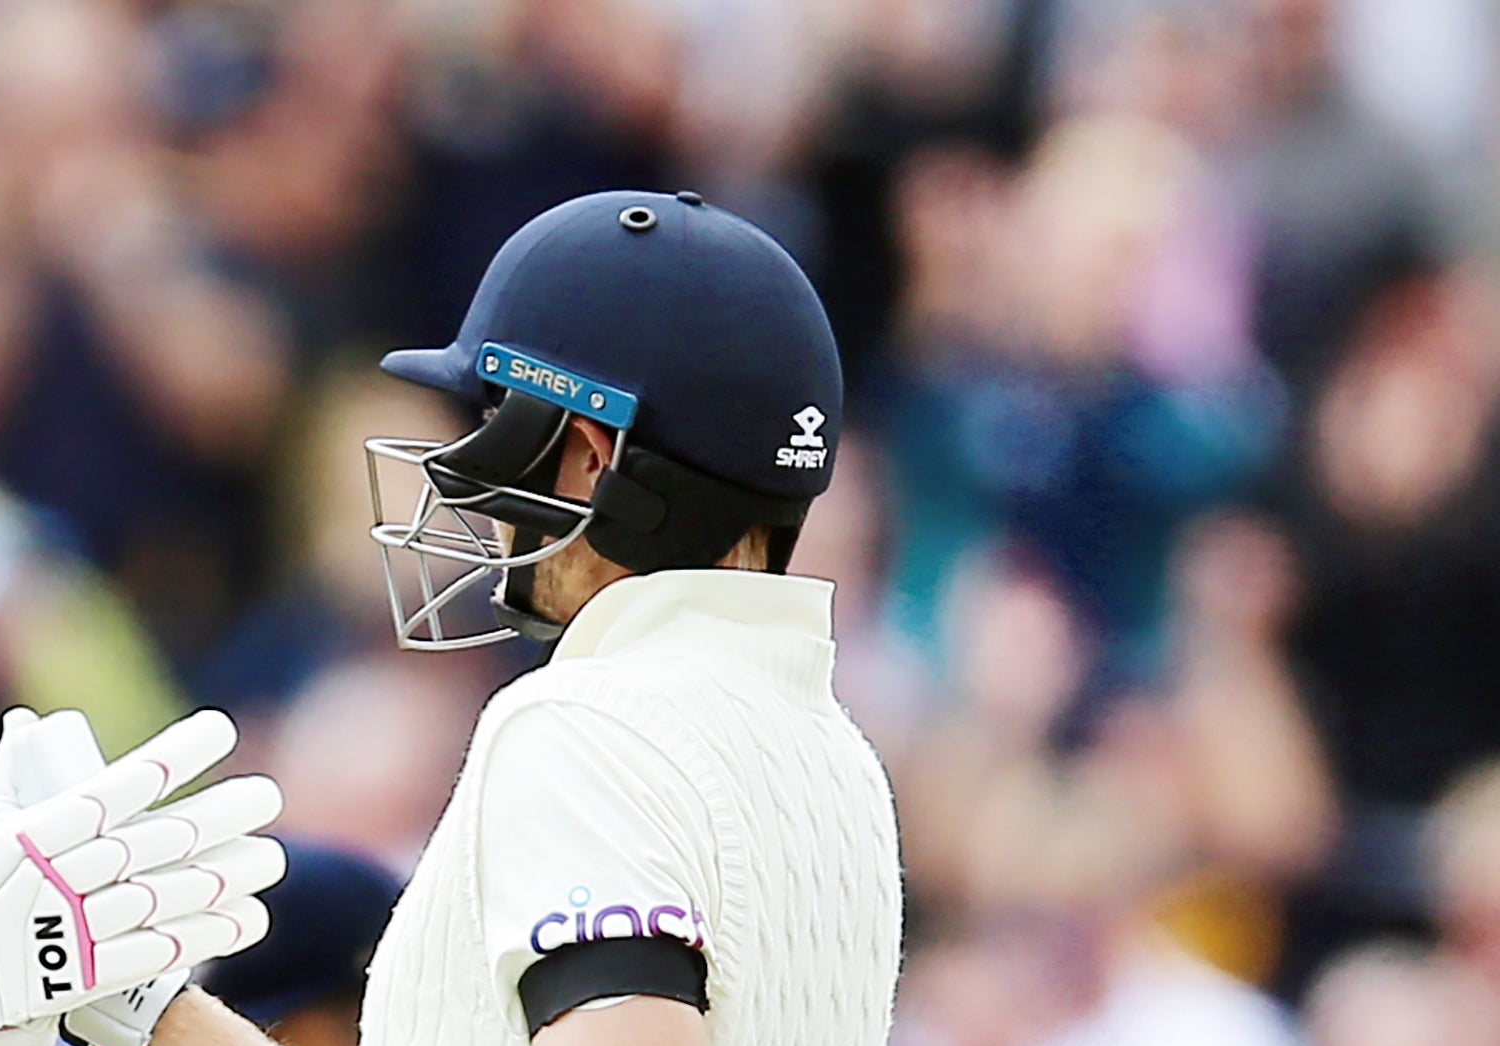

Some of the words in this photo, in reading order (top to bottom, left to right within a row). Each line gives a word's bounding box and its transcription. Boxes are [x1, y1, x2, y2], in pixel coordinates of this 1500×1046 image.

[508, 358, 583, 398] SHREY
[775, 448, 828, 468] SHREY
[530, 885, 704, 955] cinc
[34, 915, 72, 1000] TON
